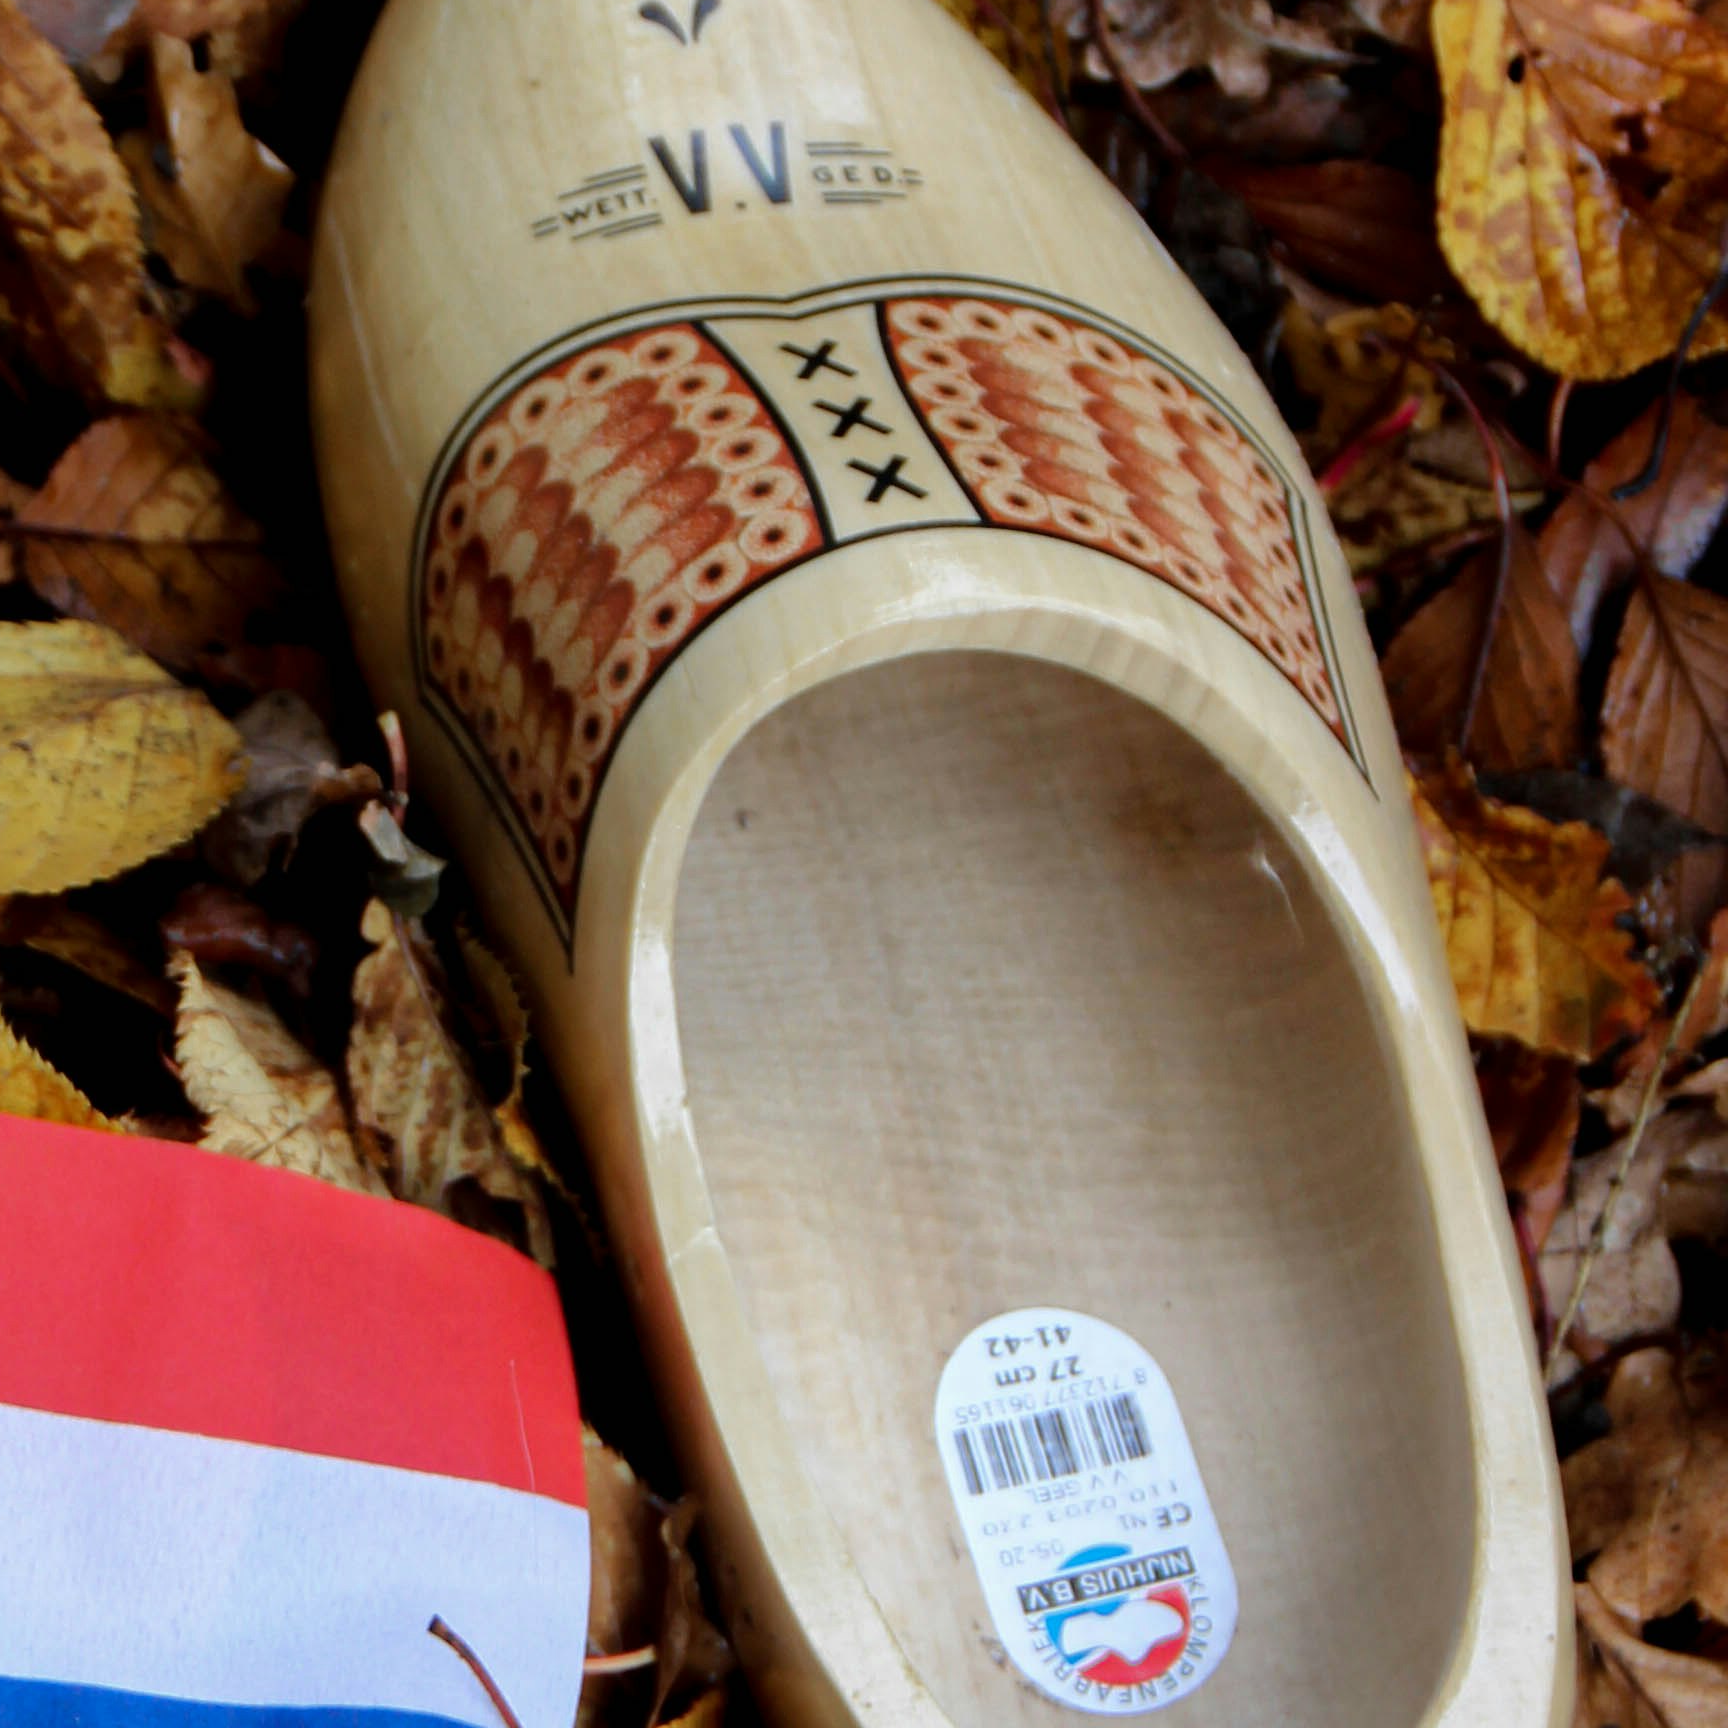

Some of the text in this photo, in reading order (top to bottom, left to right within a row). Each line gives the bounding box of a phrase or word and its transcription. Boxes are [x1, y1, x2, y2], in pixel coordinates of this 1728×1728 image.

[562, 189, 657, 226] WETT.
[983, 1325, 1070, 1358] 41-42
[995, 1356, 1082, 1387] 27 cm
[1156, 1503, 1192, 1528] CE
[1020, 1550, 1189, 1610] NIJHUIS B.V.
[1025, 1576, 1212, 1704] KLOMPENFABRIEK
